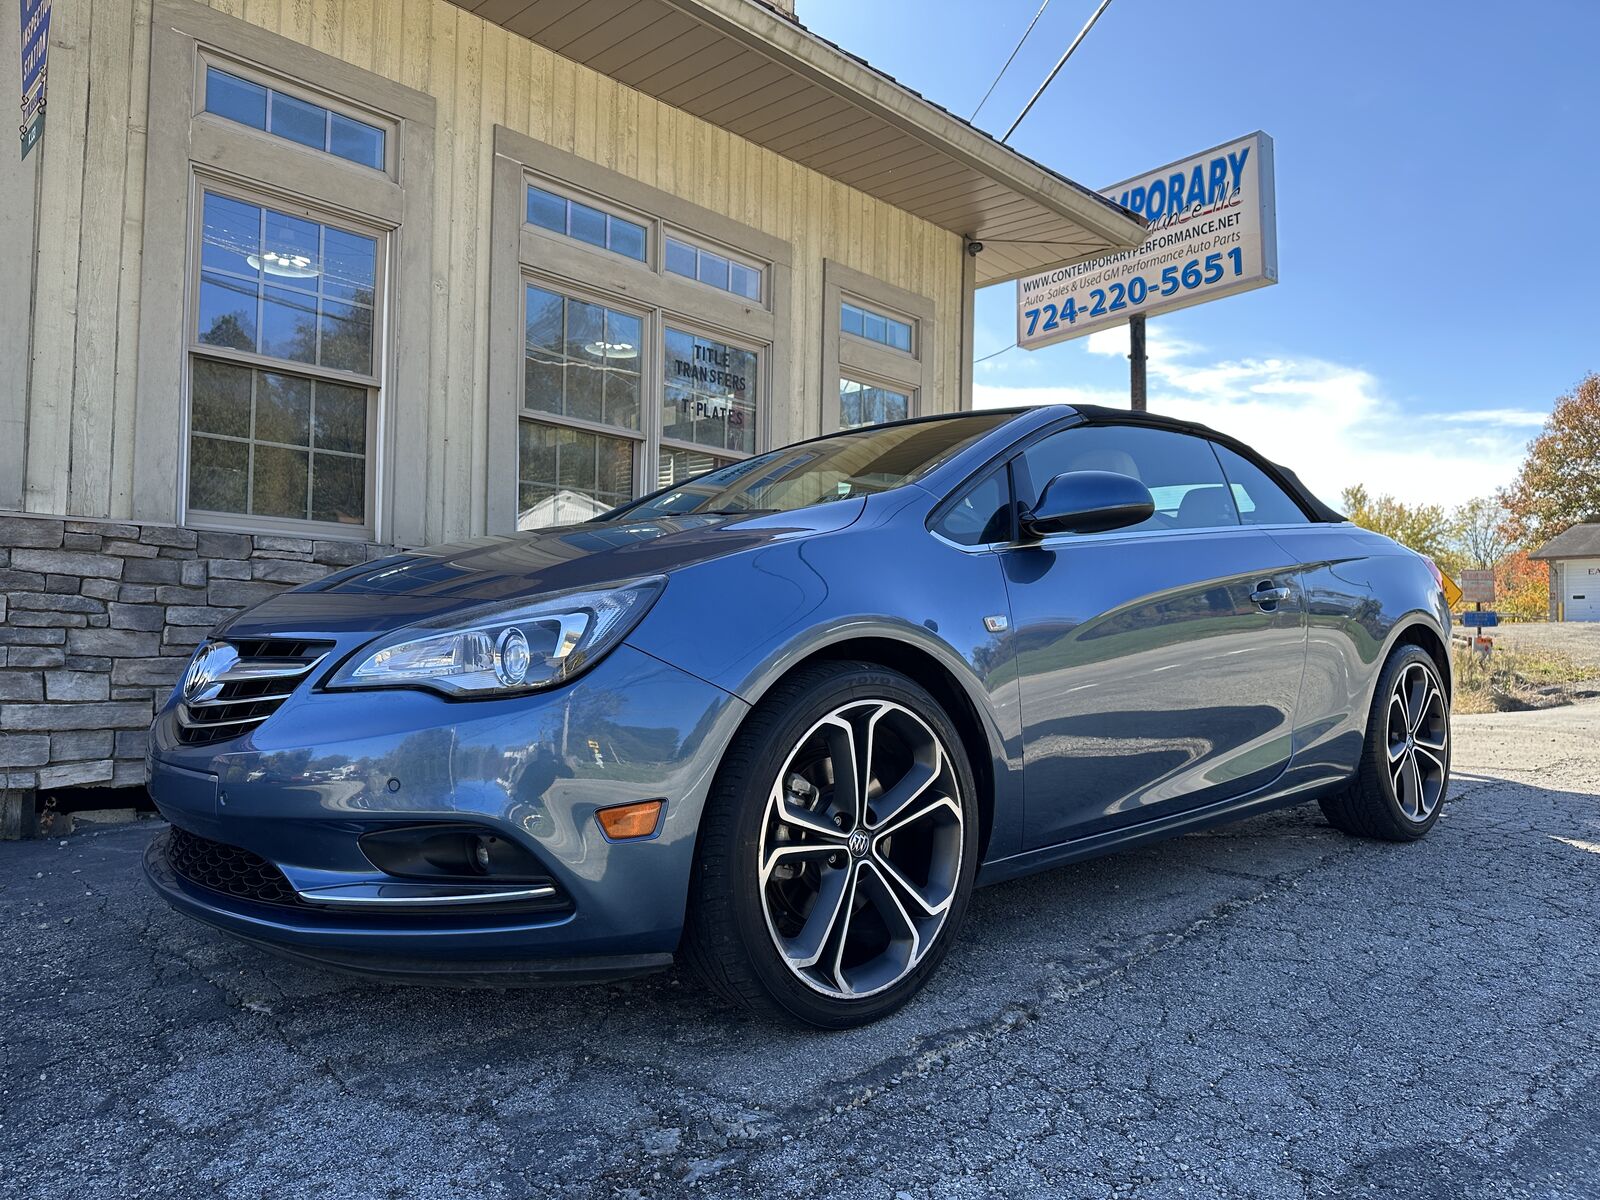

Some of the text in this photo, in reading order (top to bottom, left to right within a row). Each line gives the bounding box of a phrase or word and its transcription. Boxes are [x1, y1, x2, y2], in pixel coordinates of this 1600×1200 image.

[24, 28, 47, 81] STATION
[1023, 231, 1241, 307] Auto Sales & Used GM Performance Auto Parts
[1024, 246, 1243, 337] 724-220-5651
[674, 359, 746, 391] TRANSFERS
[694, 344, 730, 367] TITLE
